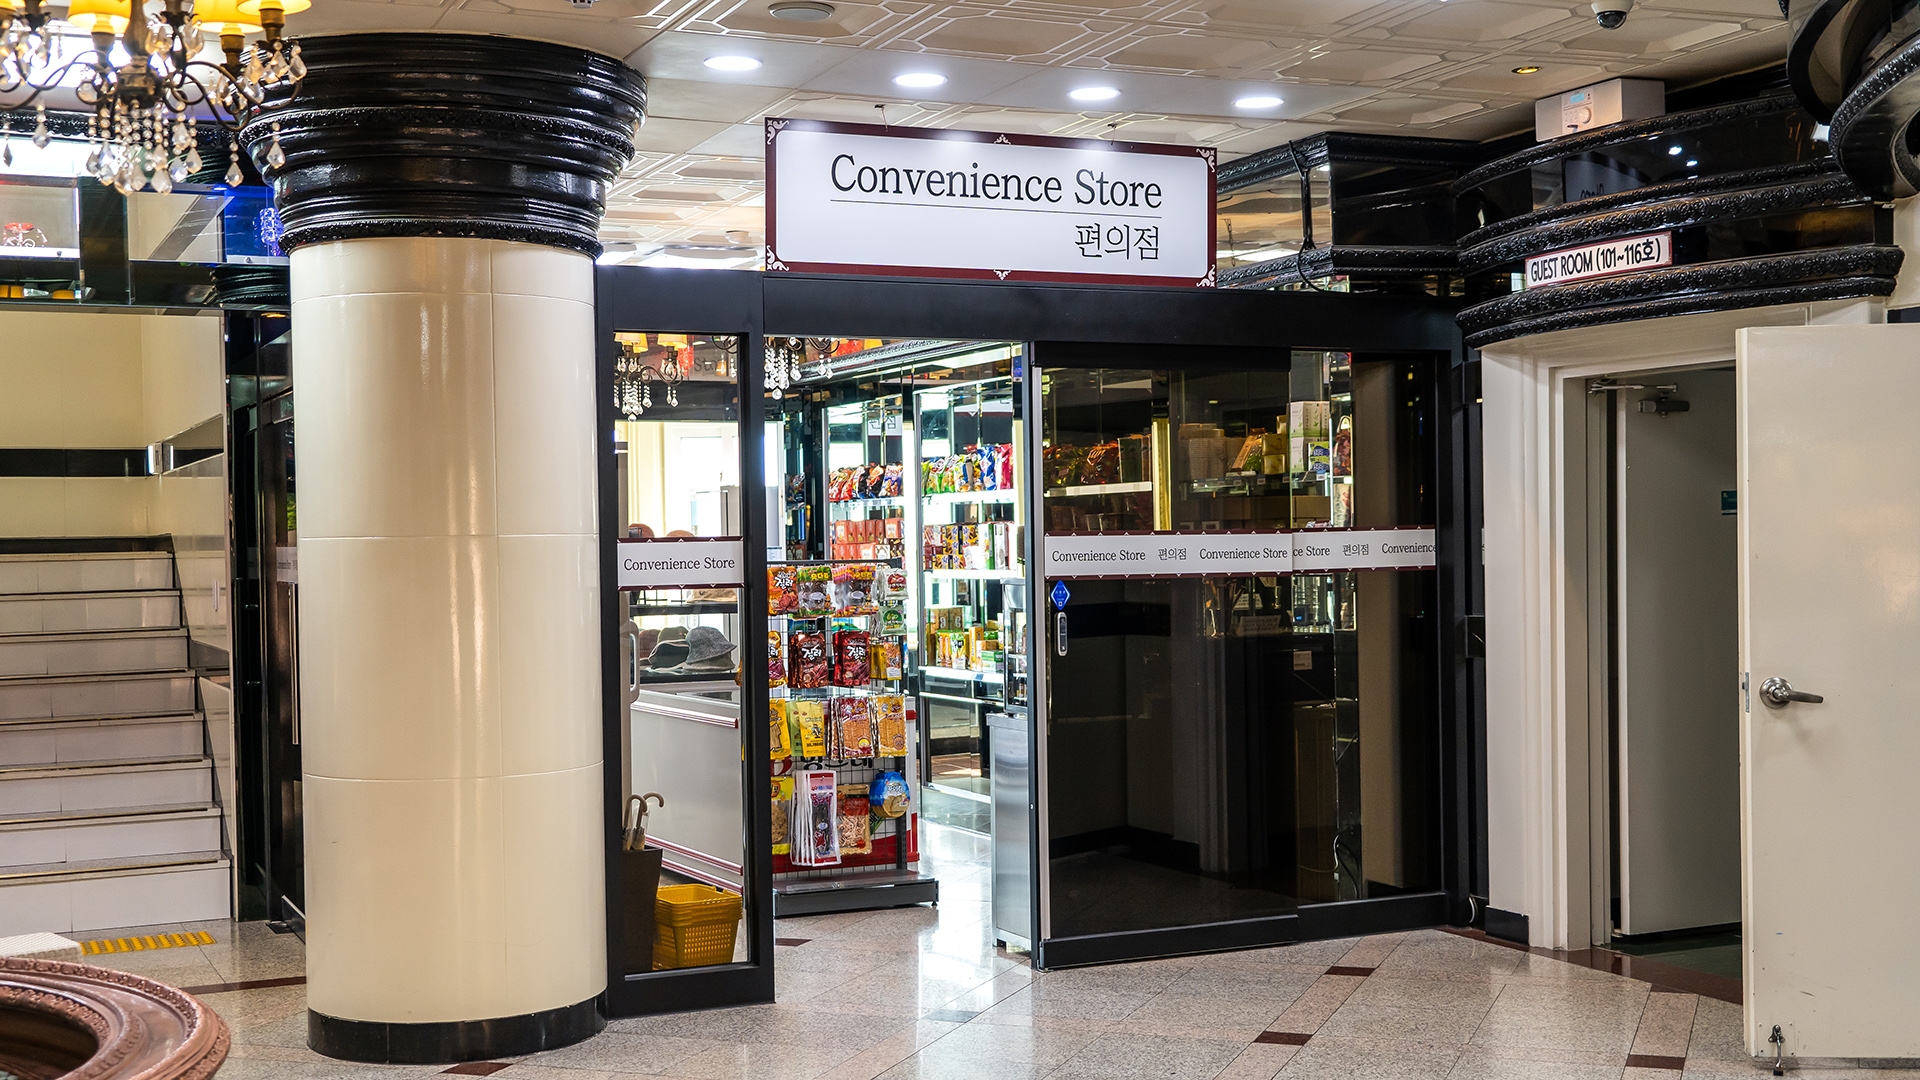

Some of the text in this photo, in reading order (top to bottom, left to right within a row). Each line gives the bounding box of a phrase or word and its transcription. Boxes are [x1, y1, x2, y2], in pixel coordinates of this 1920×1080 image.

[830, 154, 1163, 209] Convenience Store
[1075, 222, 1160, 262] 편의점
[1531, 238, 1661, 282] GUEST ROOM (101~116호)
[1157, 547, 1188, 561] 편의점
[1199, 547, 1288, 561] Convenience Store
[1306, 545, 1331, 557] Store
[1342, 543, 1370, 557] 편의점
[1382, 542, 1436, 554] Convenience
[1052, 549, 1146, 562] Convenience Store
[623, 556, 736, 571] Convenience Store
[774, 576, 794, 589] 질러
[801, 647, 823, 661] 질러
[846, 645, 866, 660] 질러
